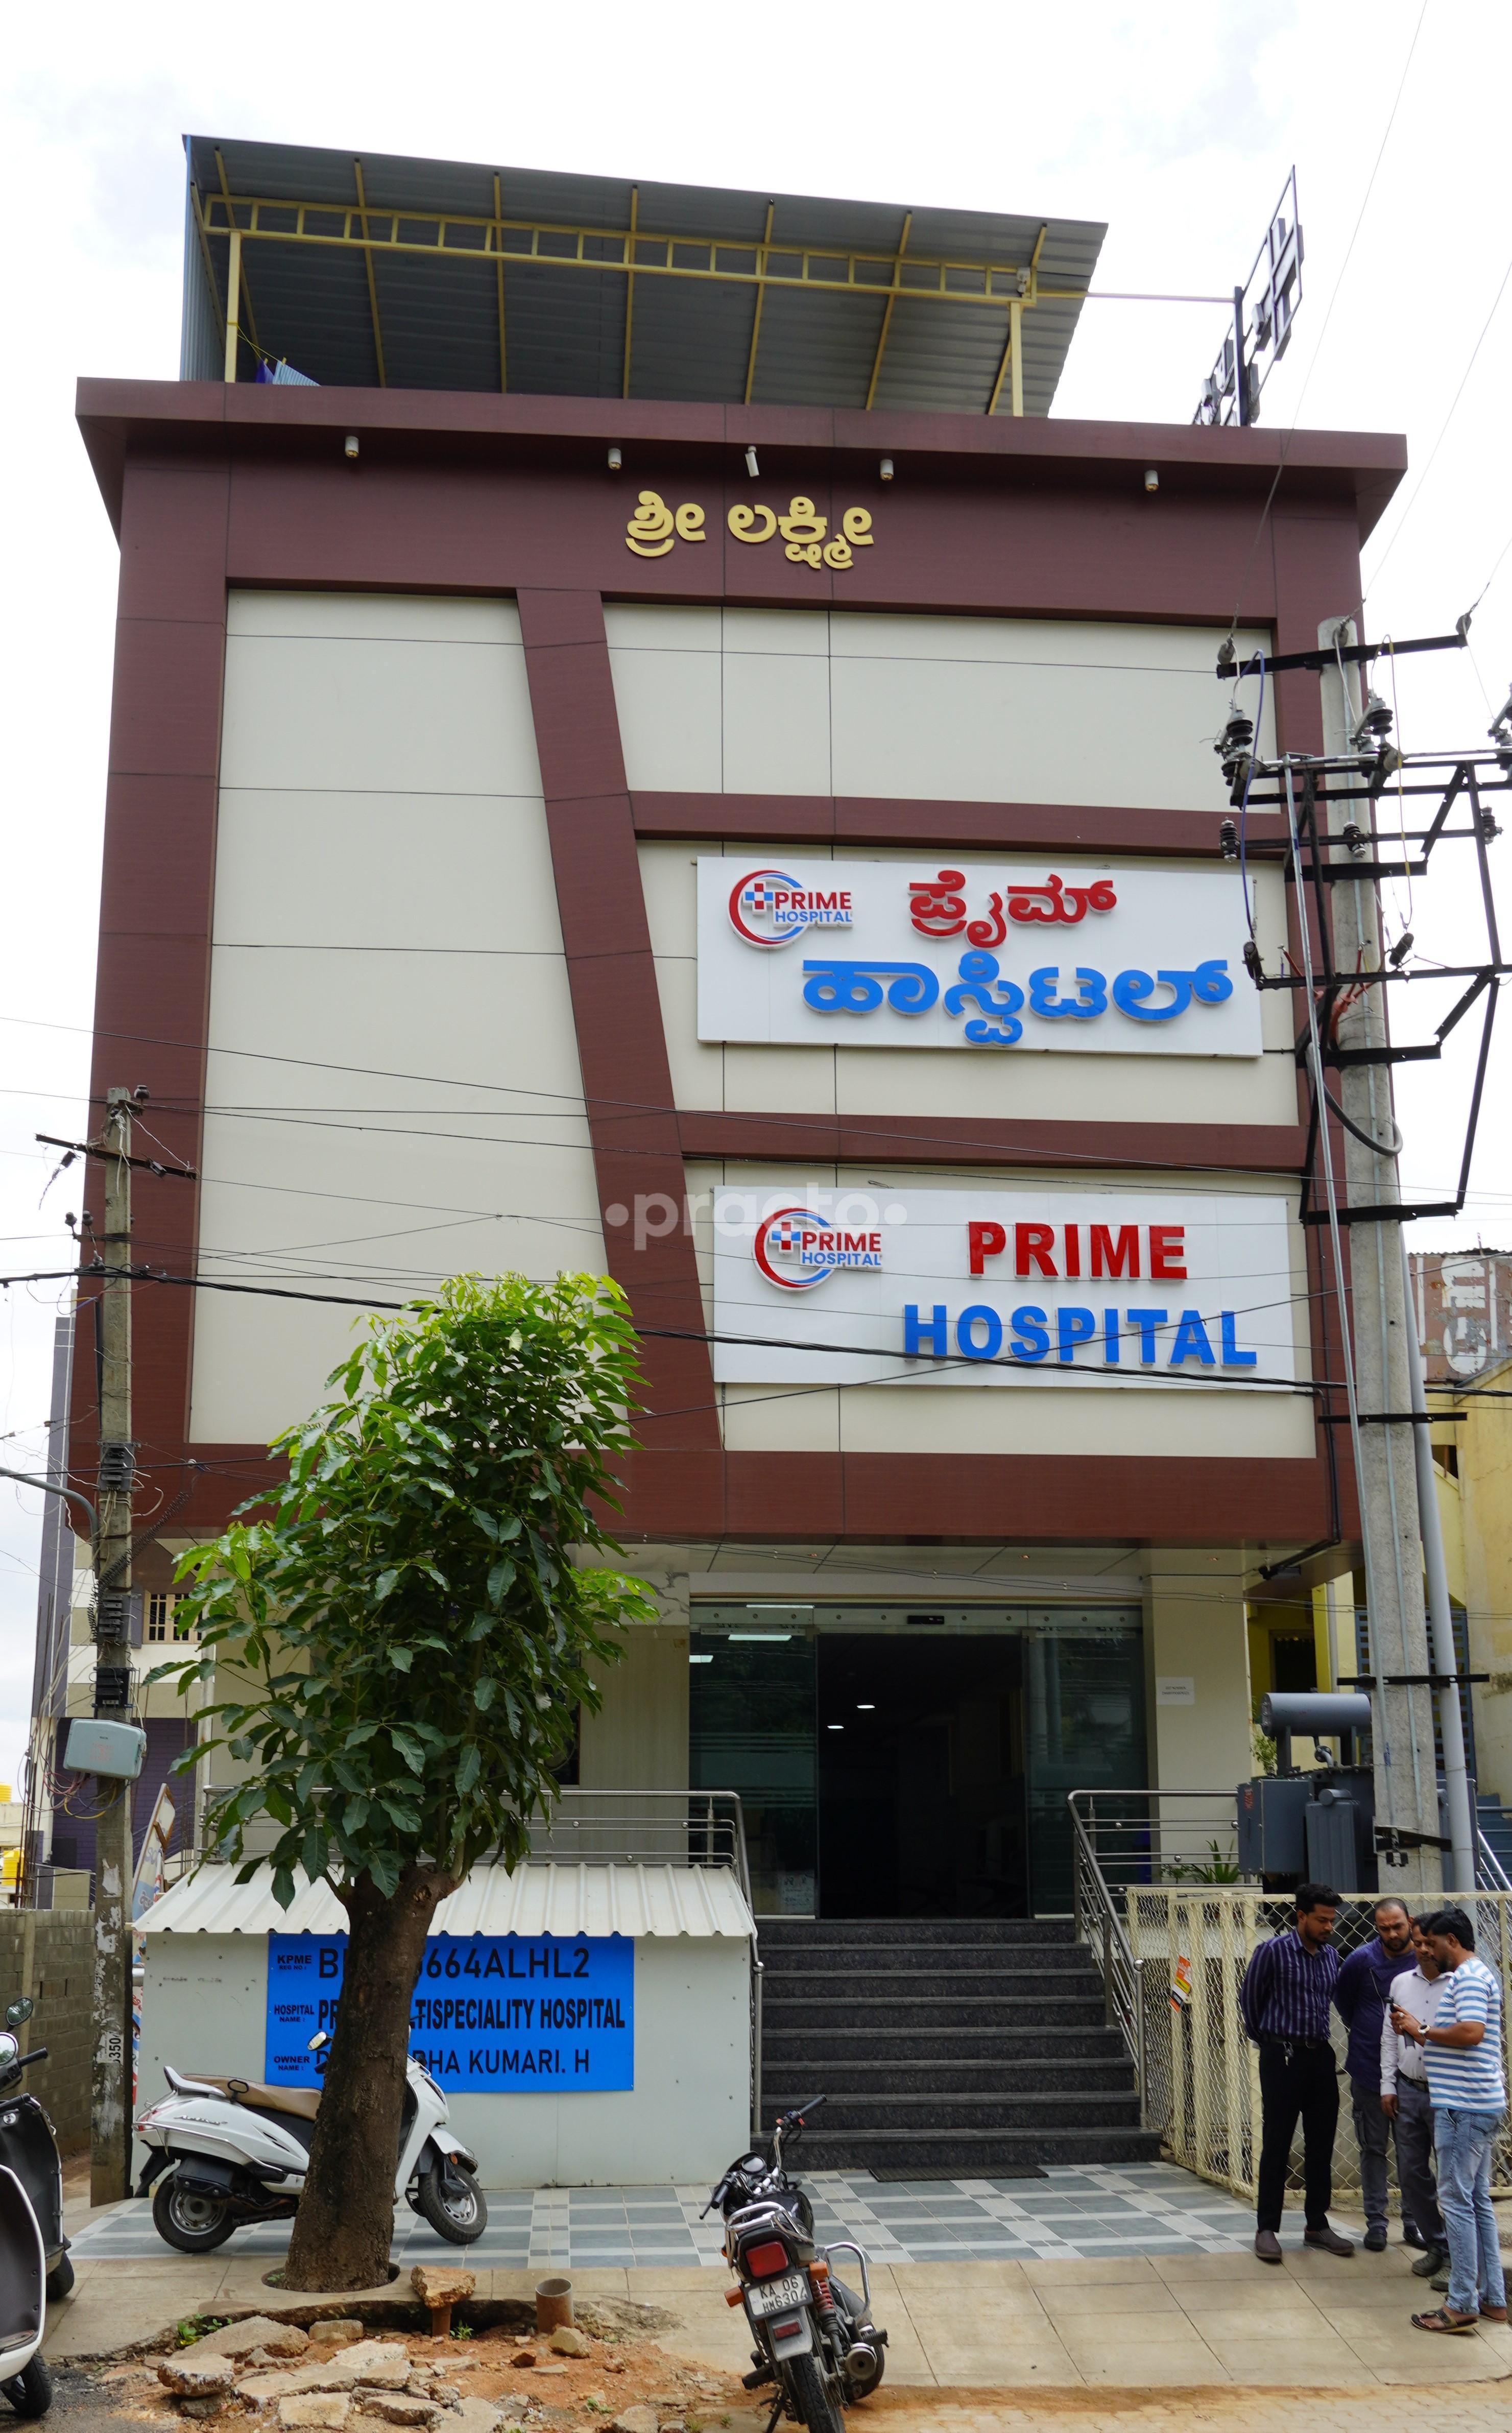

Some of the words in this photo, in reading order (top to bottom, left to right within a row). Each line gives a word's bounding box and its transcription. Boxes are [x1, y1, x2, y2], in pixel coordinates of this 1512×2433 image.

[626, 490, 706, 557] ಶ್ರೀ
[775, 892, 852, 909] PRIME
[909, 870, 1118, 949] ಪ್ರೈಮ್
[775, 911, 852, 922] HOSPITAL
[803, 950, 1234, 1045] ಹಾಸ್ಪಿಟಲ್
[802, 1231, 881, 1251] PRIME
[968, 1221, 1187, 1279] PRIME
[802, 1252, 881, 1265] HOSPITAL
[904, 1304, 1257, 1365] HOSPITAL
[277, 1955, 311, 1964] KPME
[274, 2005, 315, 2015] HOSPITAL
[540, 1998, 626, 2029] HOSPITAL
[469, 2049, 566, 2073] KUMARI.
[575, 2049, 589, 2073] H
[759, 2283, 776, 2299] KA
[782, 2276, 799, 2291] 06
